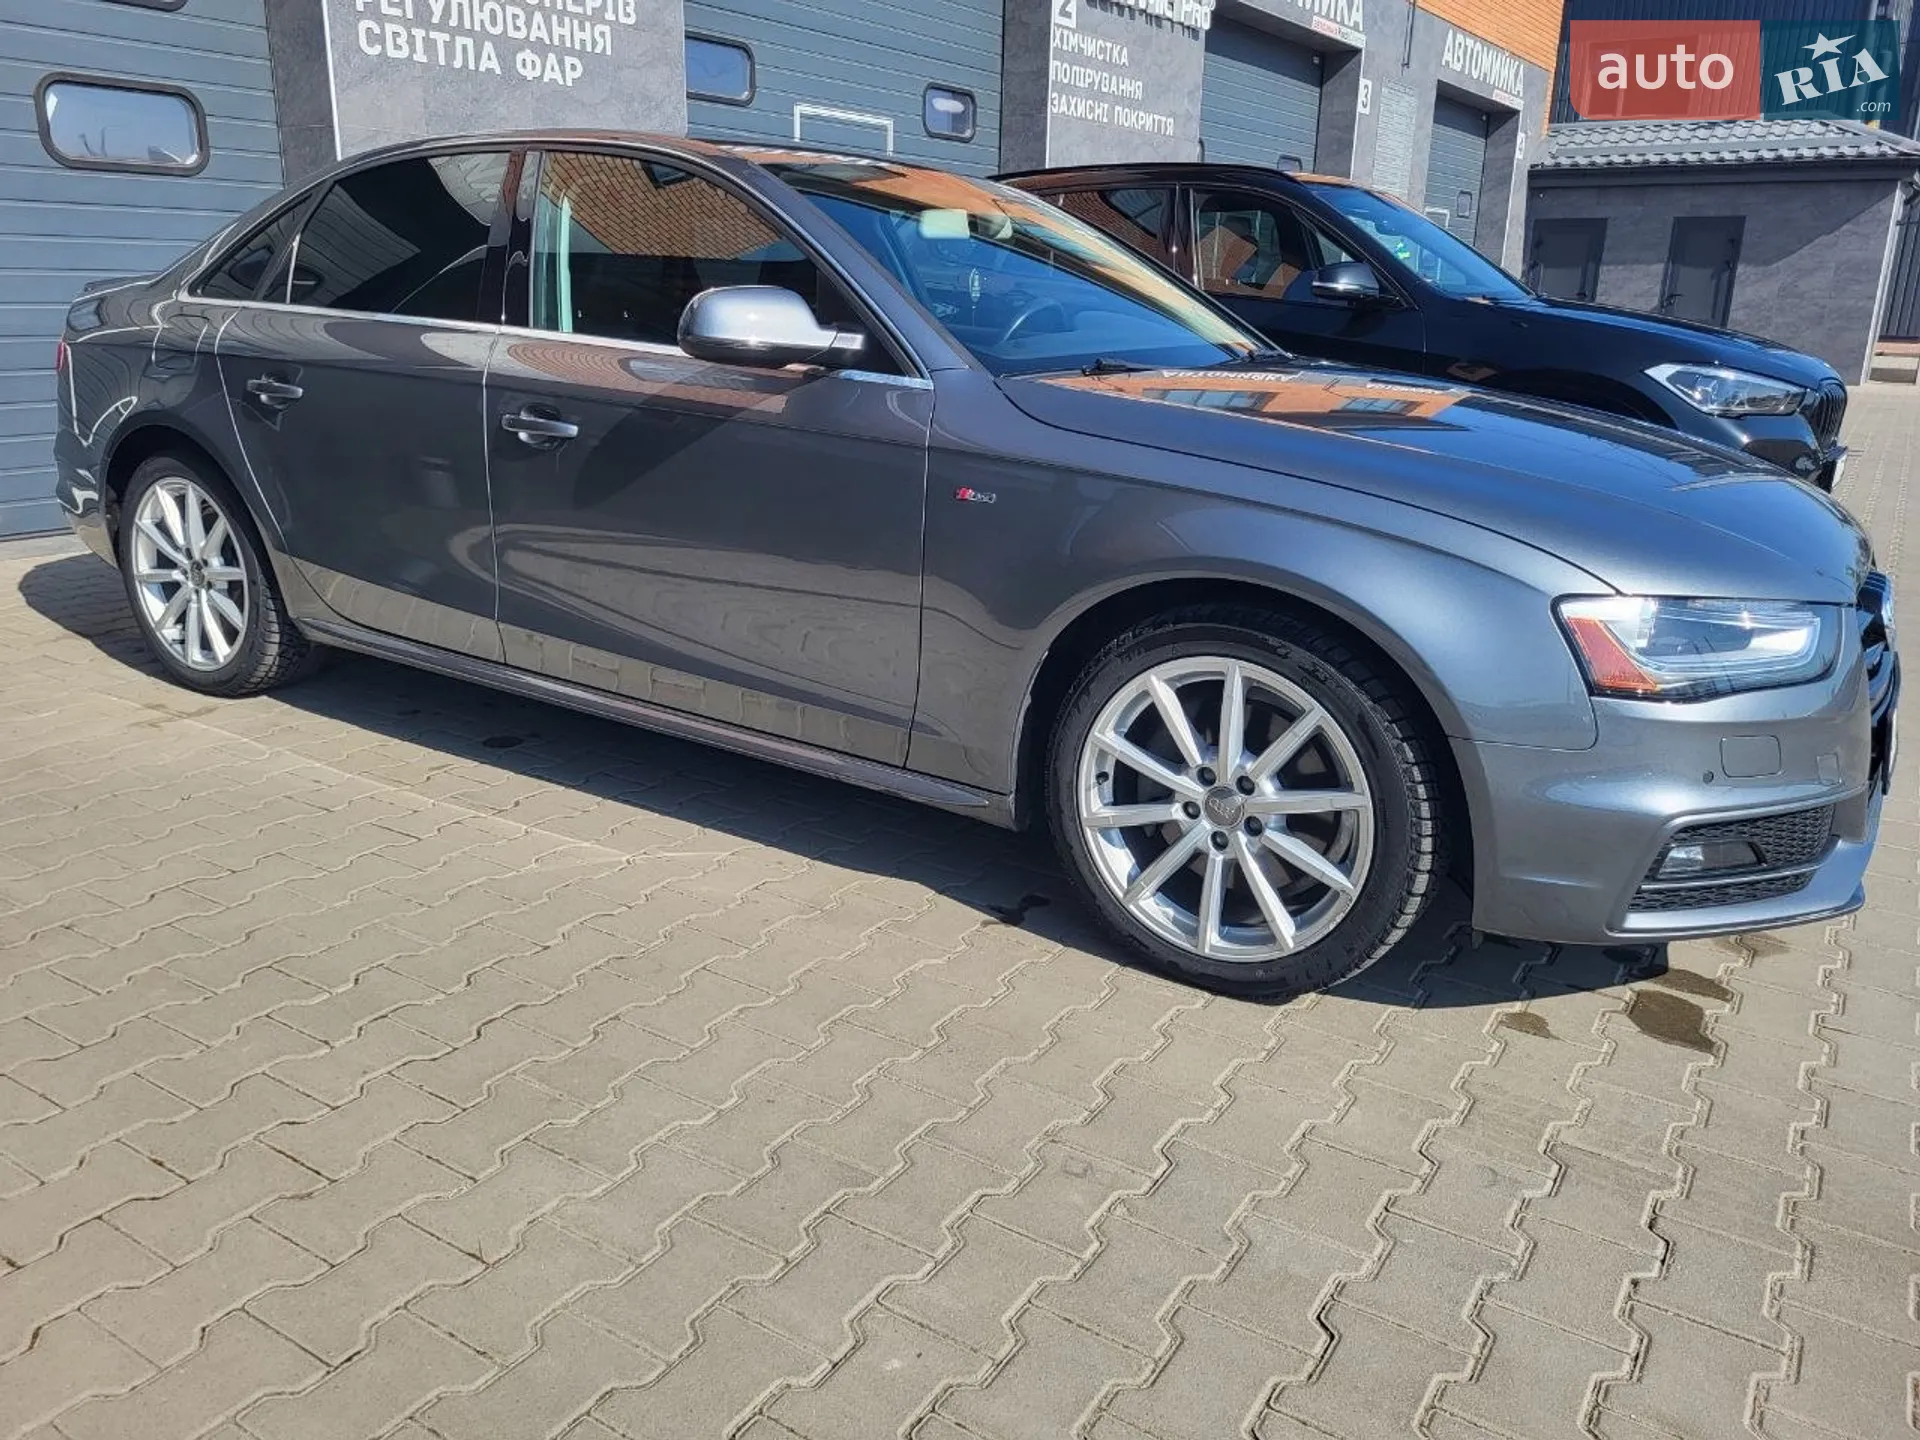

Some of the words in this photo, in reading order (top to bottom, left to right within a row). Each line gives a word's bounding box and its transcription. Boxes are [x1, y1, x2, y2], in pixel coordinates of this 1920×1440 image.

[357, 19, 502, 75] СВІТЛА
[516, 49, 583, 86] ФАР
[1052, 26, 1129, 67] ХІМЧИСТКА
[1441, 29, 1523, 96] АВТОМИЙКА
[1052, 60, 1143, 100] ПОЛІРУВАННЯ
[1051, 94, 1109, 123] ЗАХИСНІ
[1114, 106, 1174, 136] ПОКРИТТЯ
